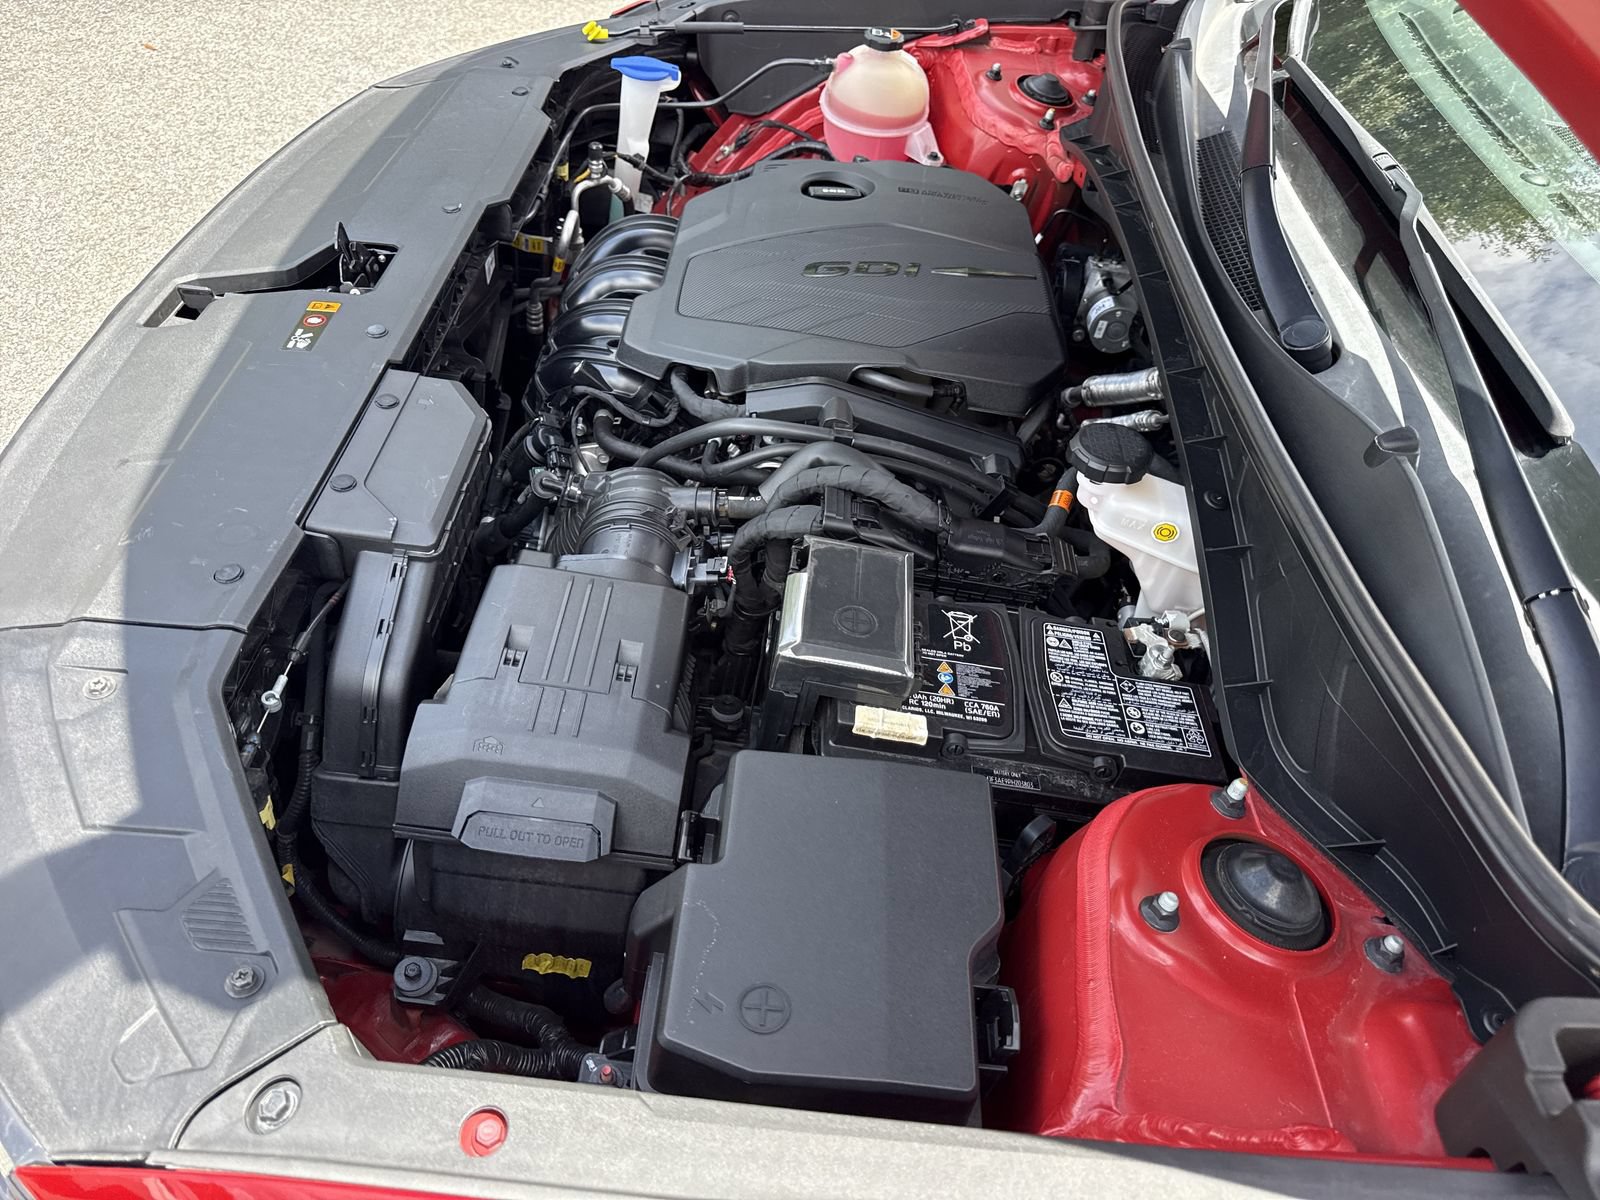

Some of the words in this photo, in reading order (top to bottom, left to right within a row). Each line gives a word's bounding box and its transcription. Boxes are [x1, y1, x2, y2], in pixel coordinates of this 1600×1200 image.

[953, 641, 972, 652] Pb
[920, 700, 946, 710] 120min
[930, 694, 955, 705] (20HR)
[964, 701, 979, 709] CCA
[478, 825, 507, 838] PULL
[509, 829, 533, 842] OUT
[536, 832, 550, 845] TO
[554, 835, 584, 849] OPEN
